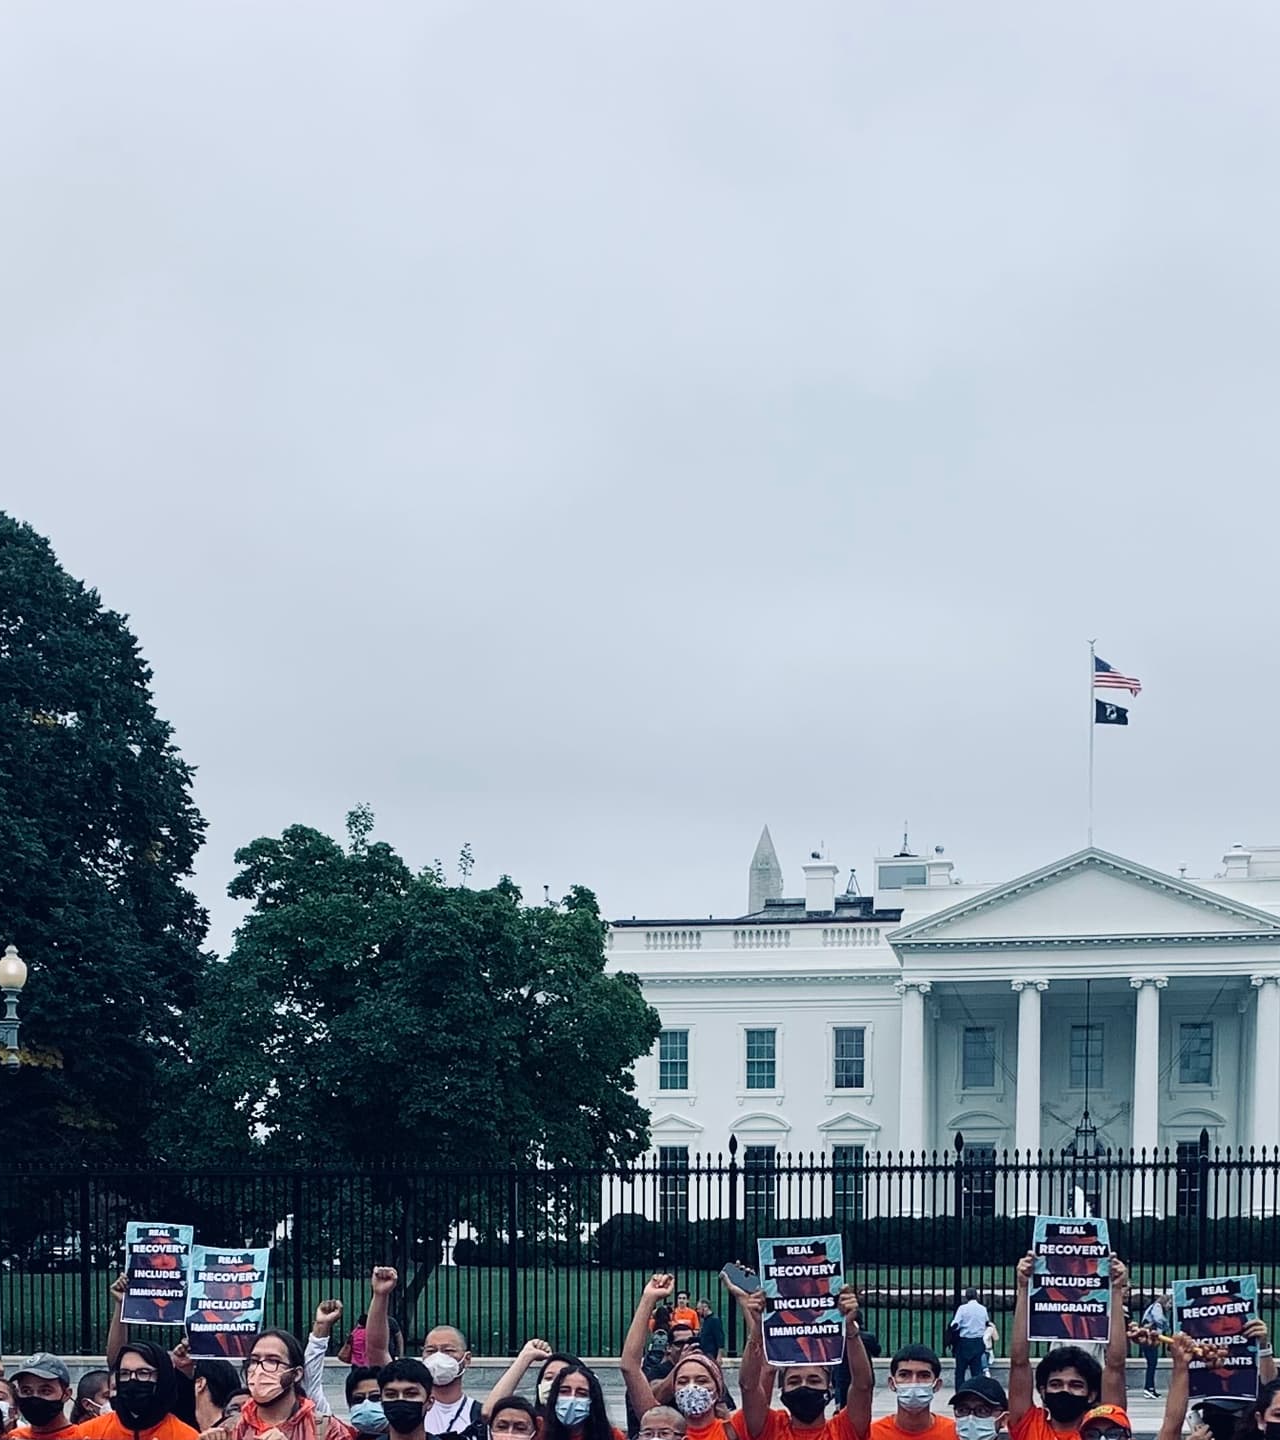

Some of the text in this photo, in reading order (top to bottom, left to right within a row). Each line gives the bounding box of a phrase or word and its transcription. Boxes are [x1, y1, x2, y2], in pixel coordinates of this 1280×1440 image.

[1059, 1226, 1086, 1234] REAL
[133, 1245, 186, 1254] RECOVERY
[787, 1246, 814, 1255] REAL
[1040, 1244, 1106, 1255] RECOVERY
[218, 1256, 243, 1264] REAL
[134, 1270, 180, 1279] INCLUDES
[769, 1264, 836, 1277] RECOVERY
[198, 1272, 261, 1282] RECOVERY
[1041, 1277, 1101, 1287] INCLUDES
[130, 1288, 183, 1297] IMMIGRANTS
[1201, 1285, 1229, 1295] REAL
[199, 1300, 254, 1310] INCLUDES
[774, 1297, 835, 1309] INCLUDES
[1035, 1303, 1104, 1313] IMMIGRANTS
[1183, 1302, 1251, 1318] RECOVERY
[191, 1323, 256, 1332] IMMIGRANTS
[770, 1324, 840, 1337] IMMIGRANTS
[1192, 1335, 1248, 1345] NCLUDES
